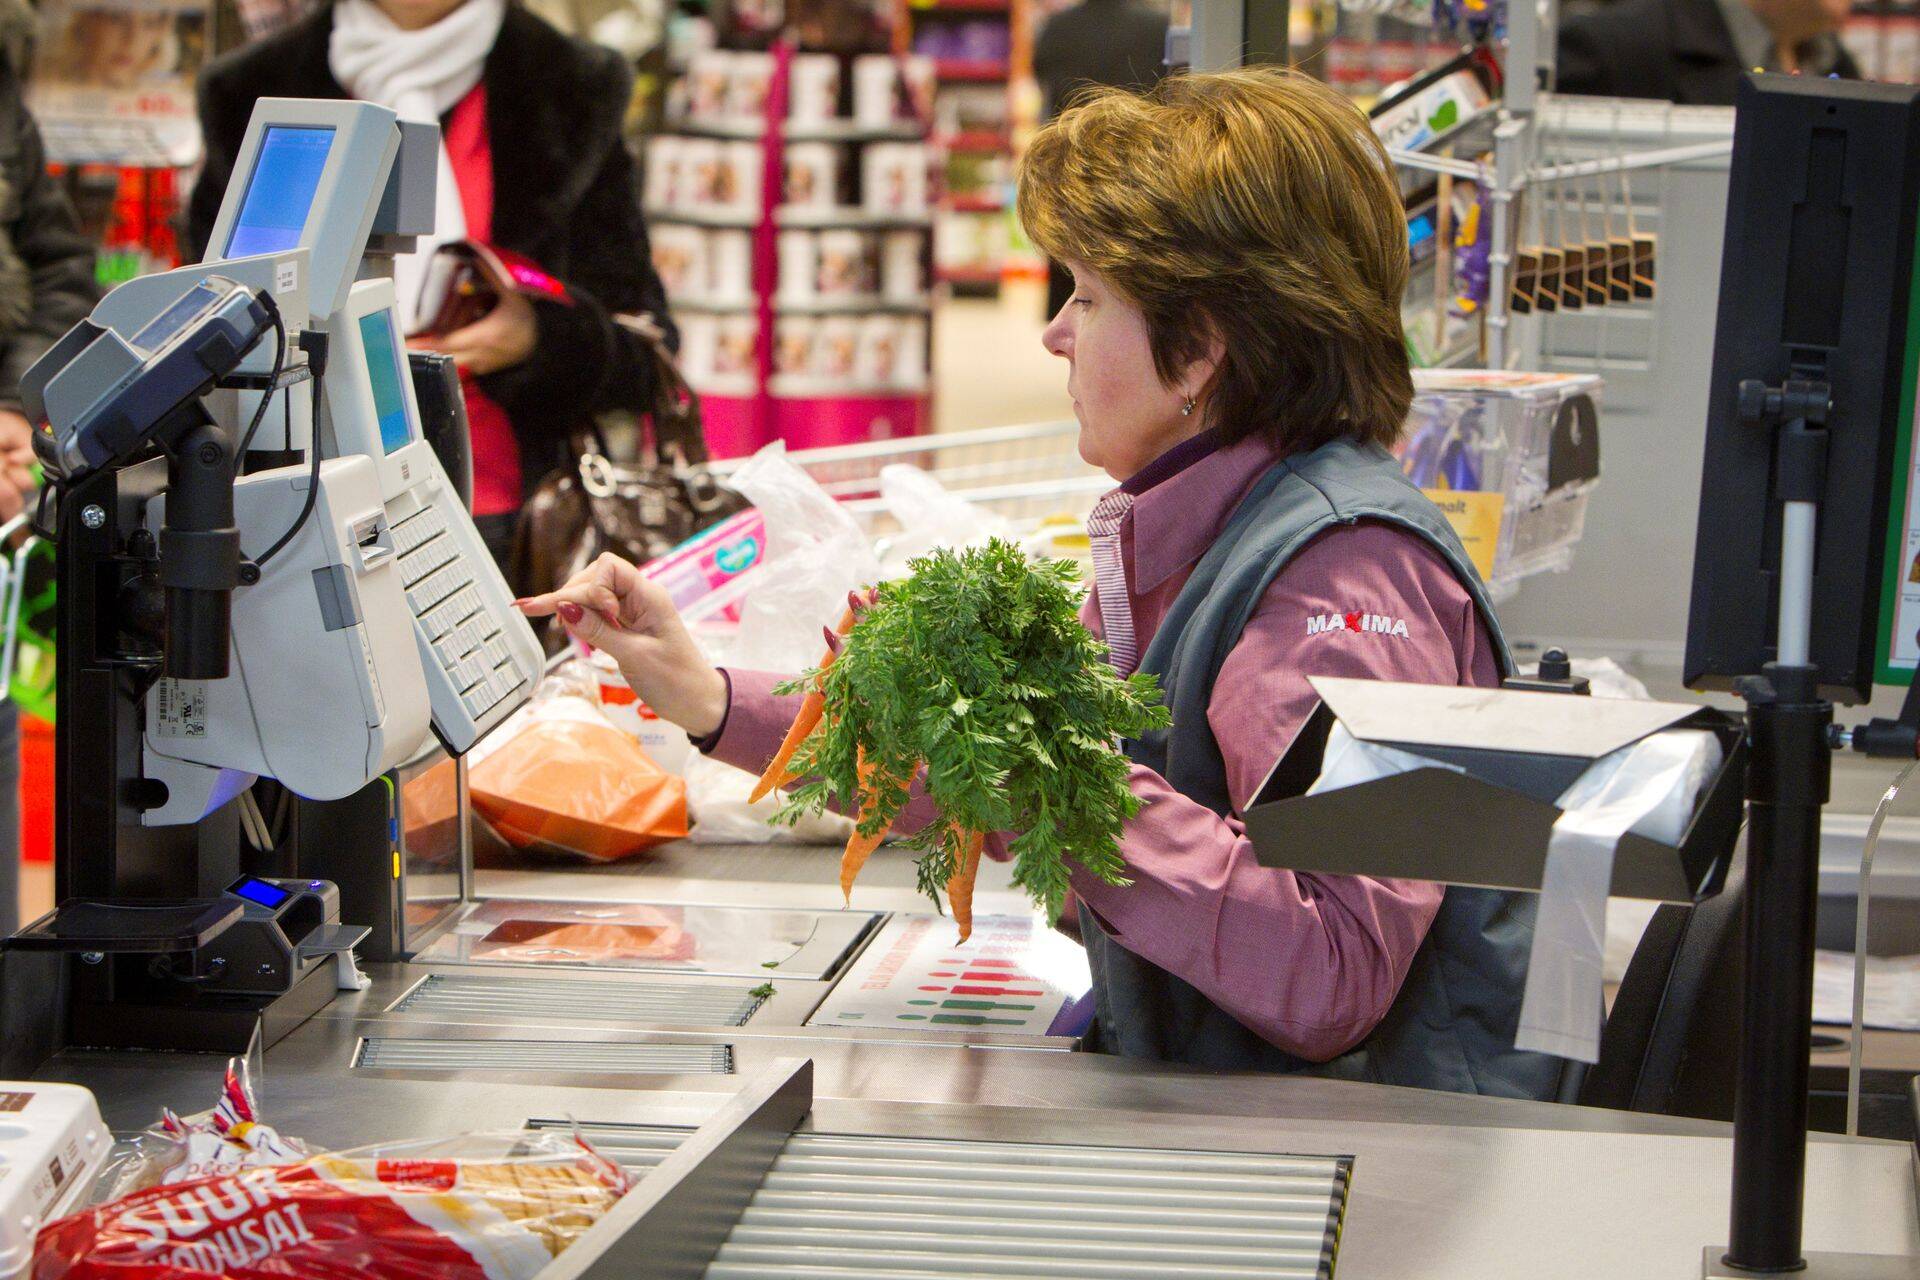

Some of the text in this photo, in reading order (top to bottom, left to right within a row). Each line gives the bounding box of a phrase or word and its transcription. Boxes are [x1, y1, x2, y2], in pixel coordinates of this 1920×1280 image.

[1307, 611, 1409, 639] MAXIMA
[119, 1167, 292, 1250] SUUR
[149, 1203, 314, 1275] ODUSAI
